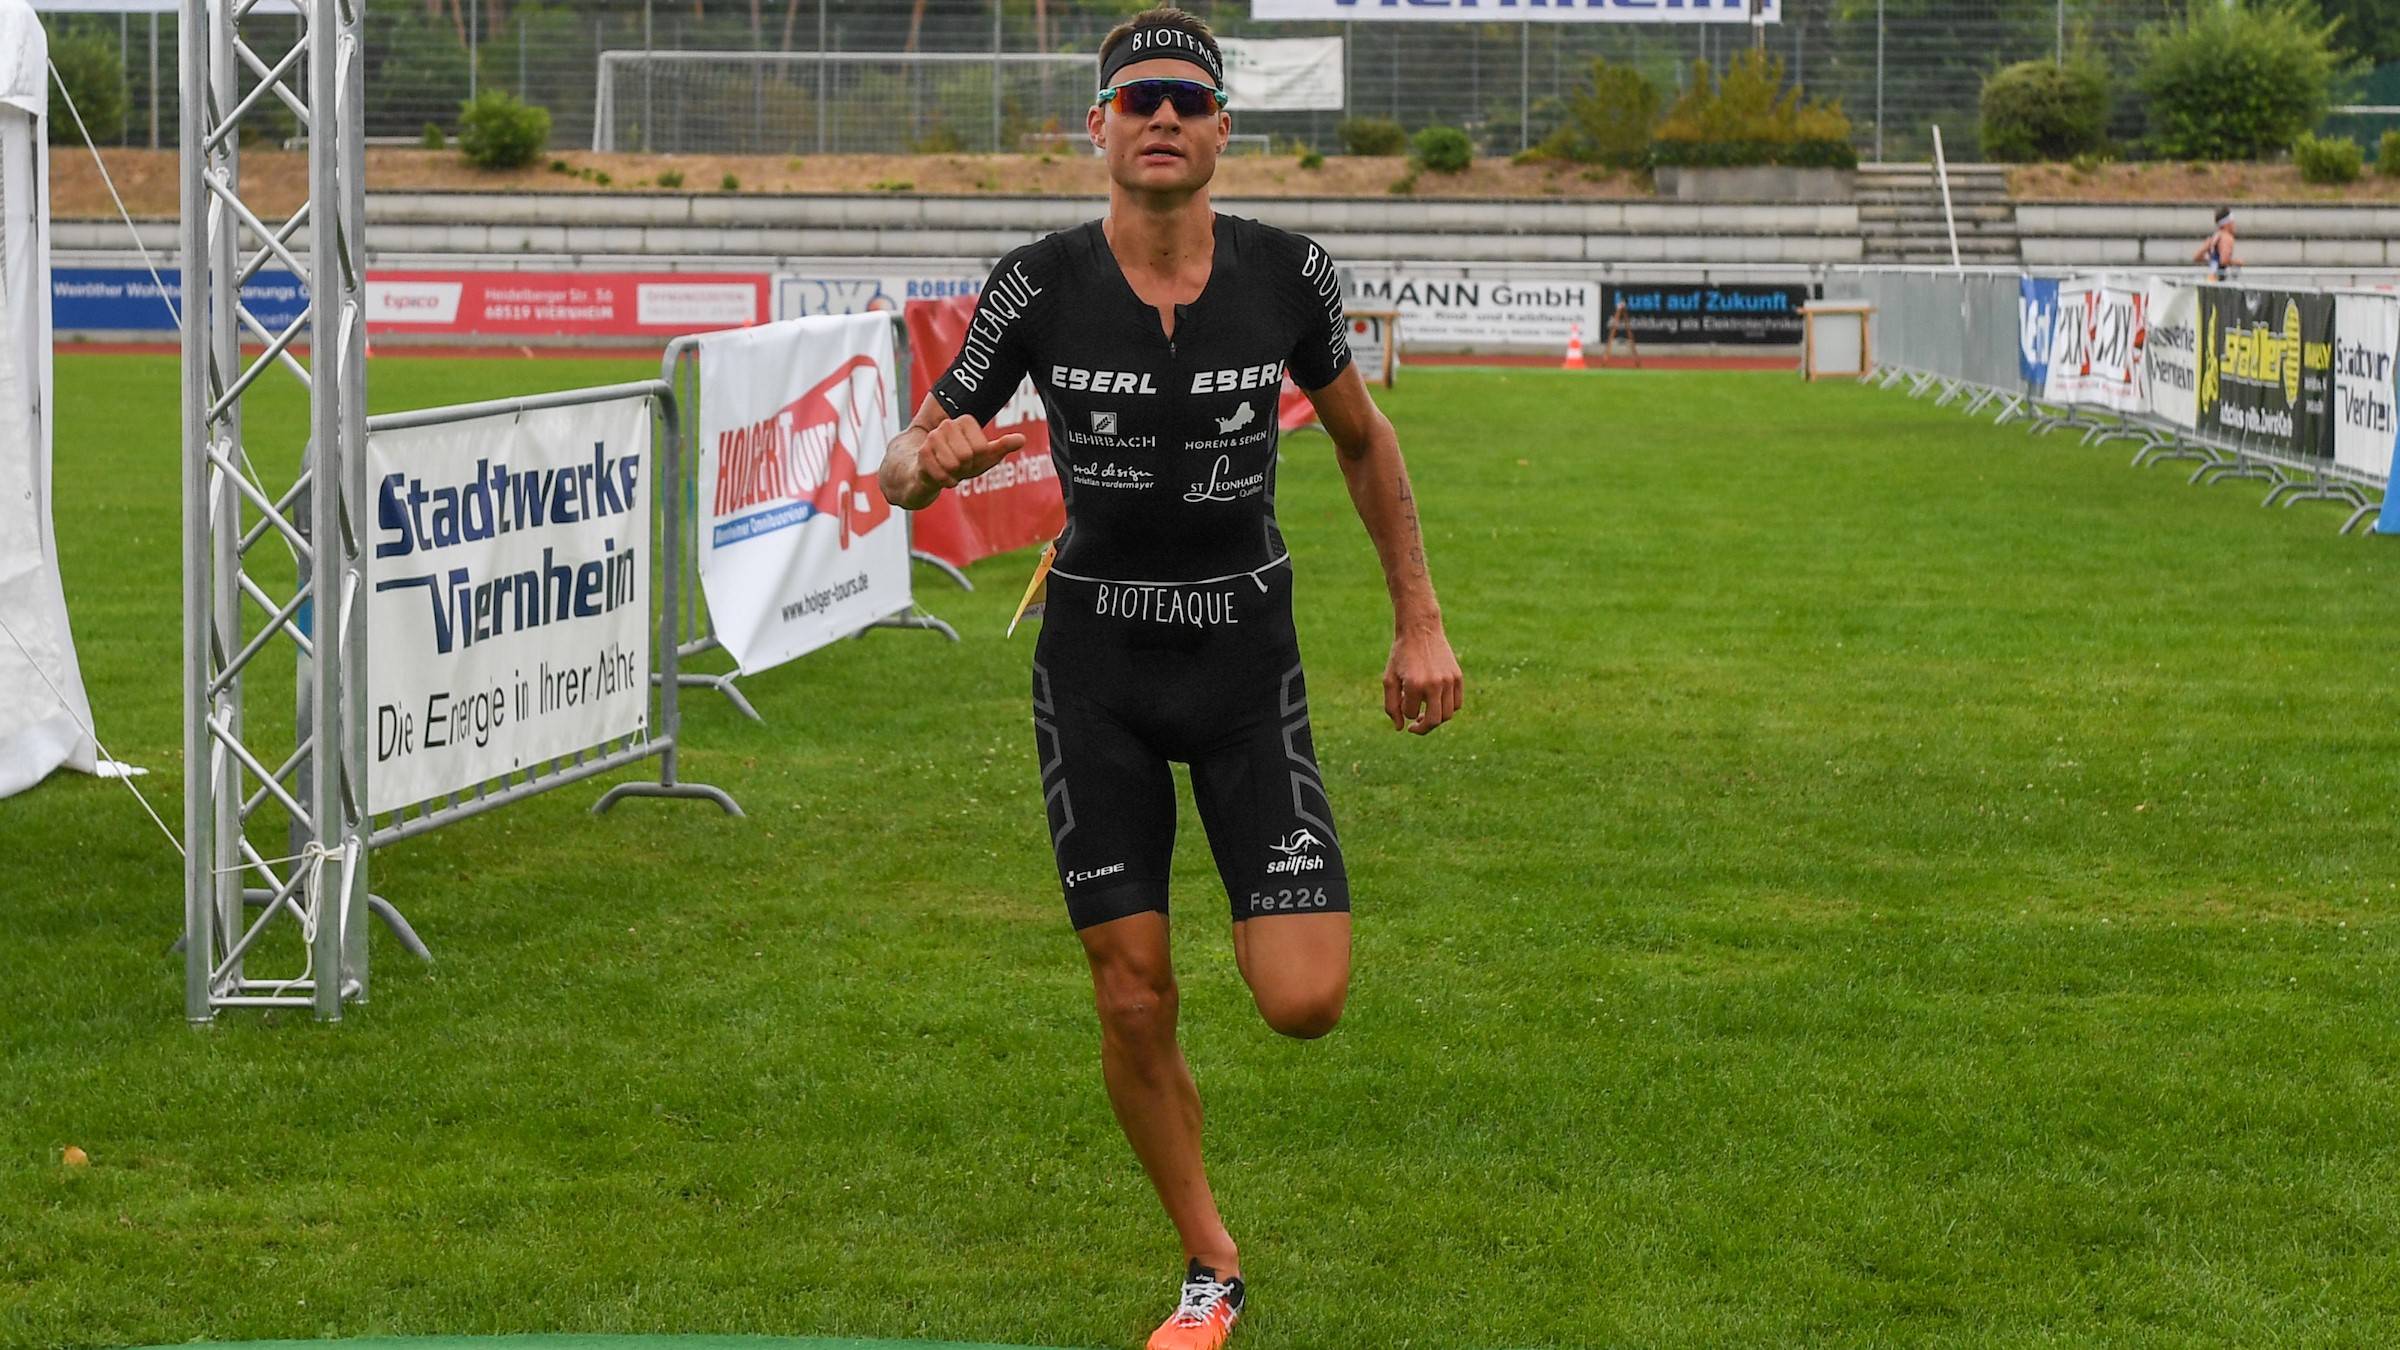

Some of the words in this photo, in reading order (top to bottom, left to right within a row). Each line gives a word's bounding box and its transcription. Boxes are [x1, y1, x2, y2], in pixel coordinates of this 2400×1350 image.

[485, 288, 566, 303] Heidelberger
[1491, 286, 1585, 308] GmbH
[1614, 289, 1660, 311] Lust
[1667, 289, 1700, 311] auf
[1706, 289, 1788, 312] Zukunft
[535, 305, 613, 320] VIERNHEIM
[952, 260, 1042, 393] BIOTEAQUE
[1051, 364, 1158, 395] EBERL
[1190, 358, 1286, 395] EBERL
[1069, 430, 1157, 448] LEHRBACH
[1229, 438, 1237, 447] &
[1239, 429, 1268, 446] SEHEN
[1073, 476, 1100, 487] christian
[1101, 462, 1155, 482] design
[1190, 482, 1204, 493] ST
[375, 441, 641, 560] Stadtwerke
[781, 571, 868, 622] www.holger-tours.de
[1096, 583, 1239, 628] BIOTEAQUE
[377, 700, 413, 762] Die
[423, 676, 505, 749] Energie
[514, 668, 530, 722] in
[539, 660, 592, 716] Ihrer
[1076, 862, 1125, 882] CUBE
[1266, 855, 1324, 876] sailfish
[1251, 888, 1328, 912] Fe226
